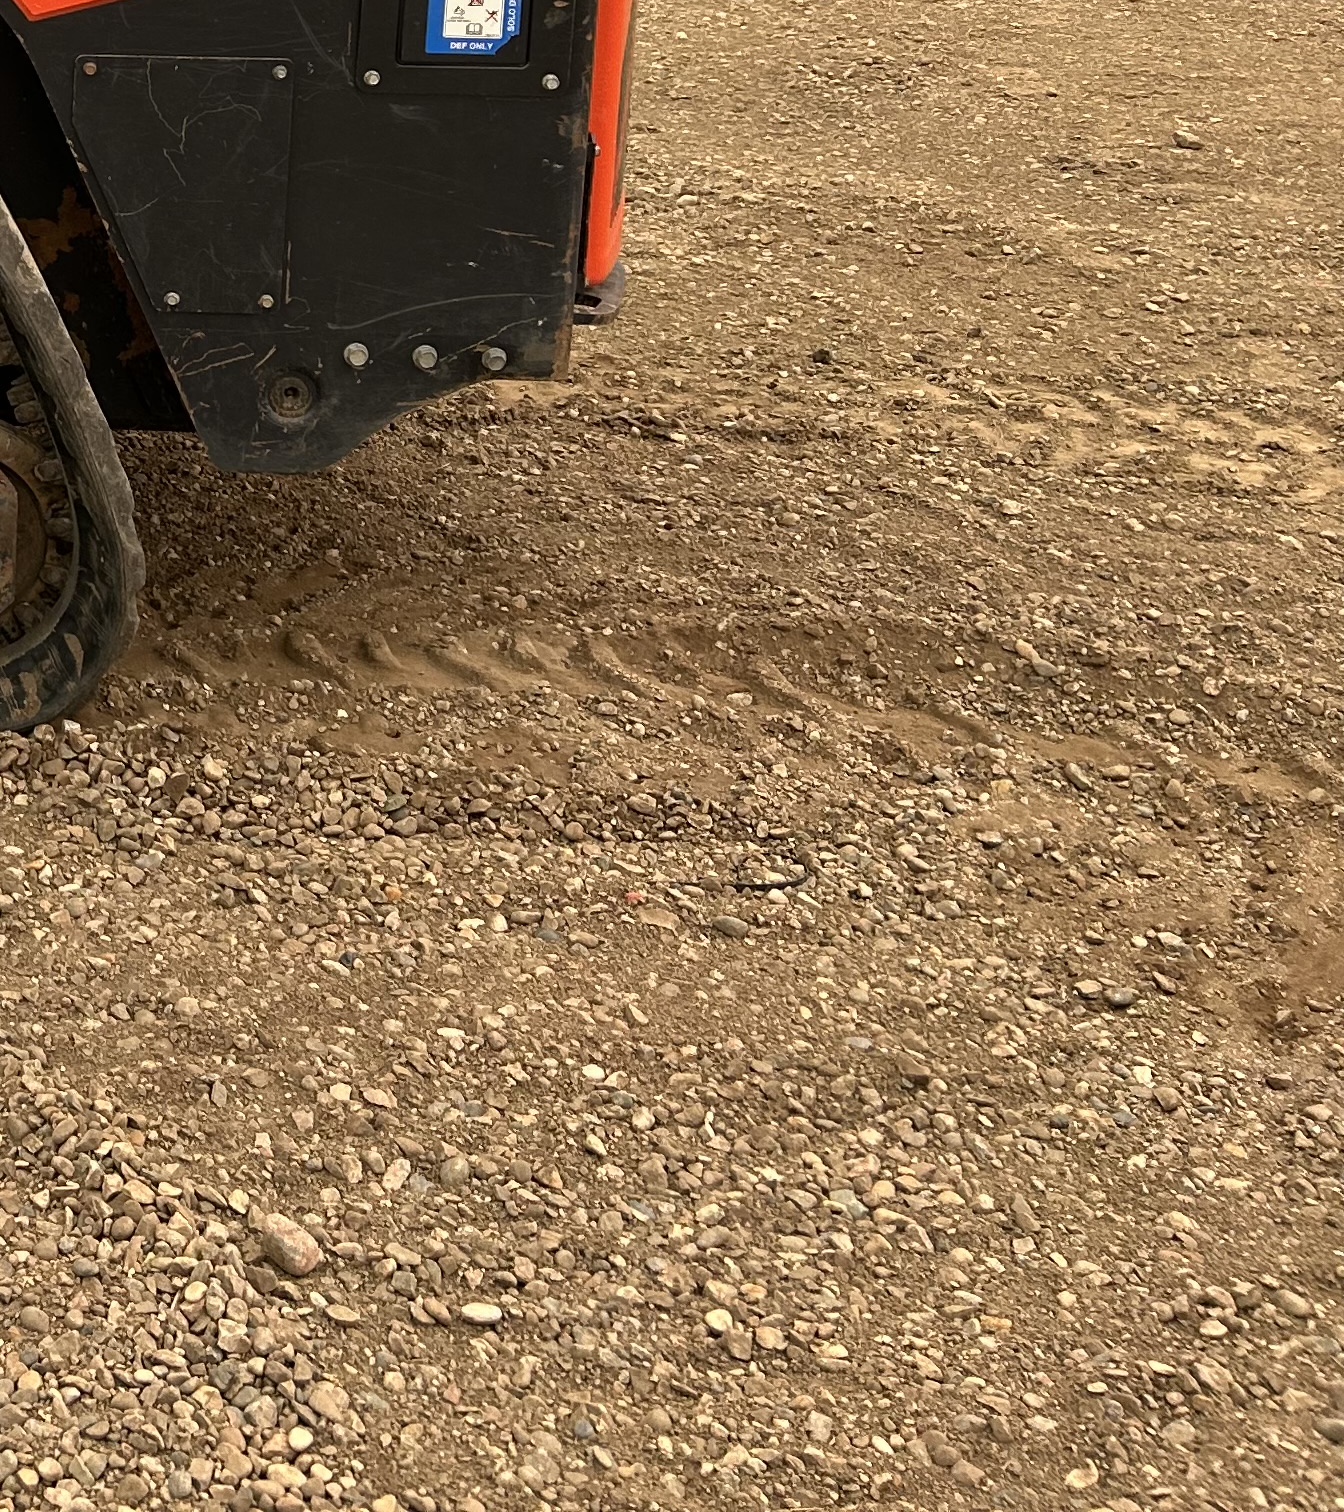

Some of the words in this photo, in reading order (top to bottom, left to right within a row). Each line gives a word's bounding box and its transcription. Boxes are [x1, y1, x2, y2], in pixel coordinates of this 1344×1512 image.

[506, 8, 516, 32] SOLO
[450, 42, 468, 50] DEF
[469, 42, 494, 50] ONLY
